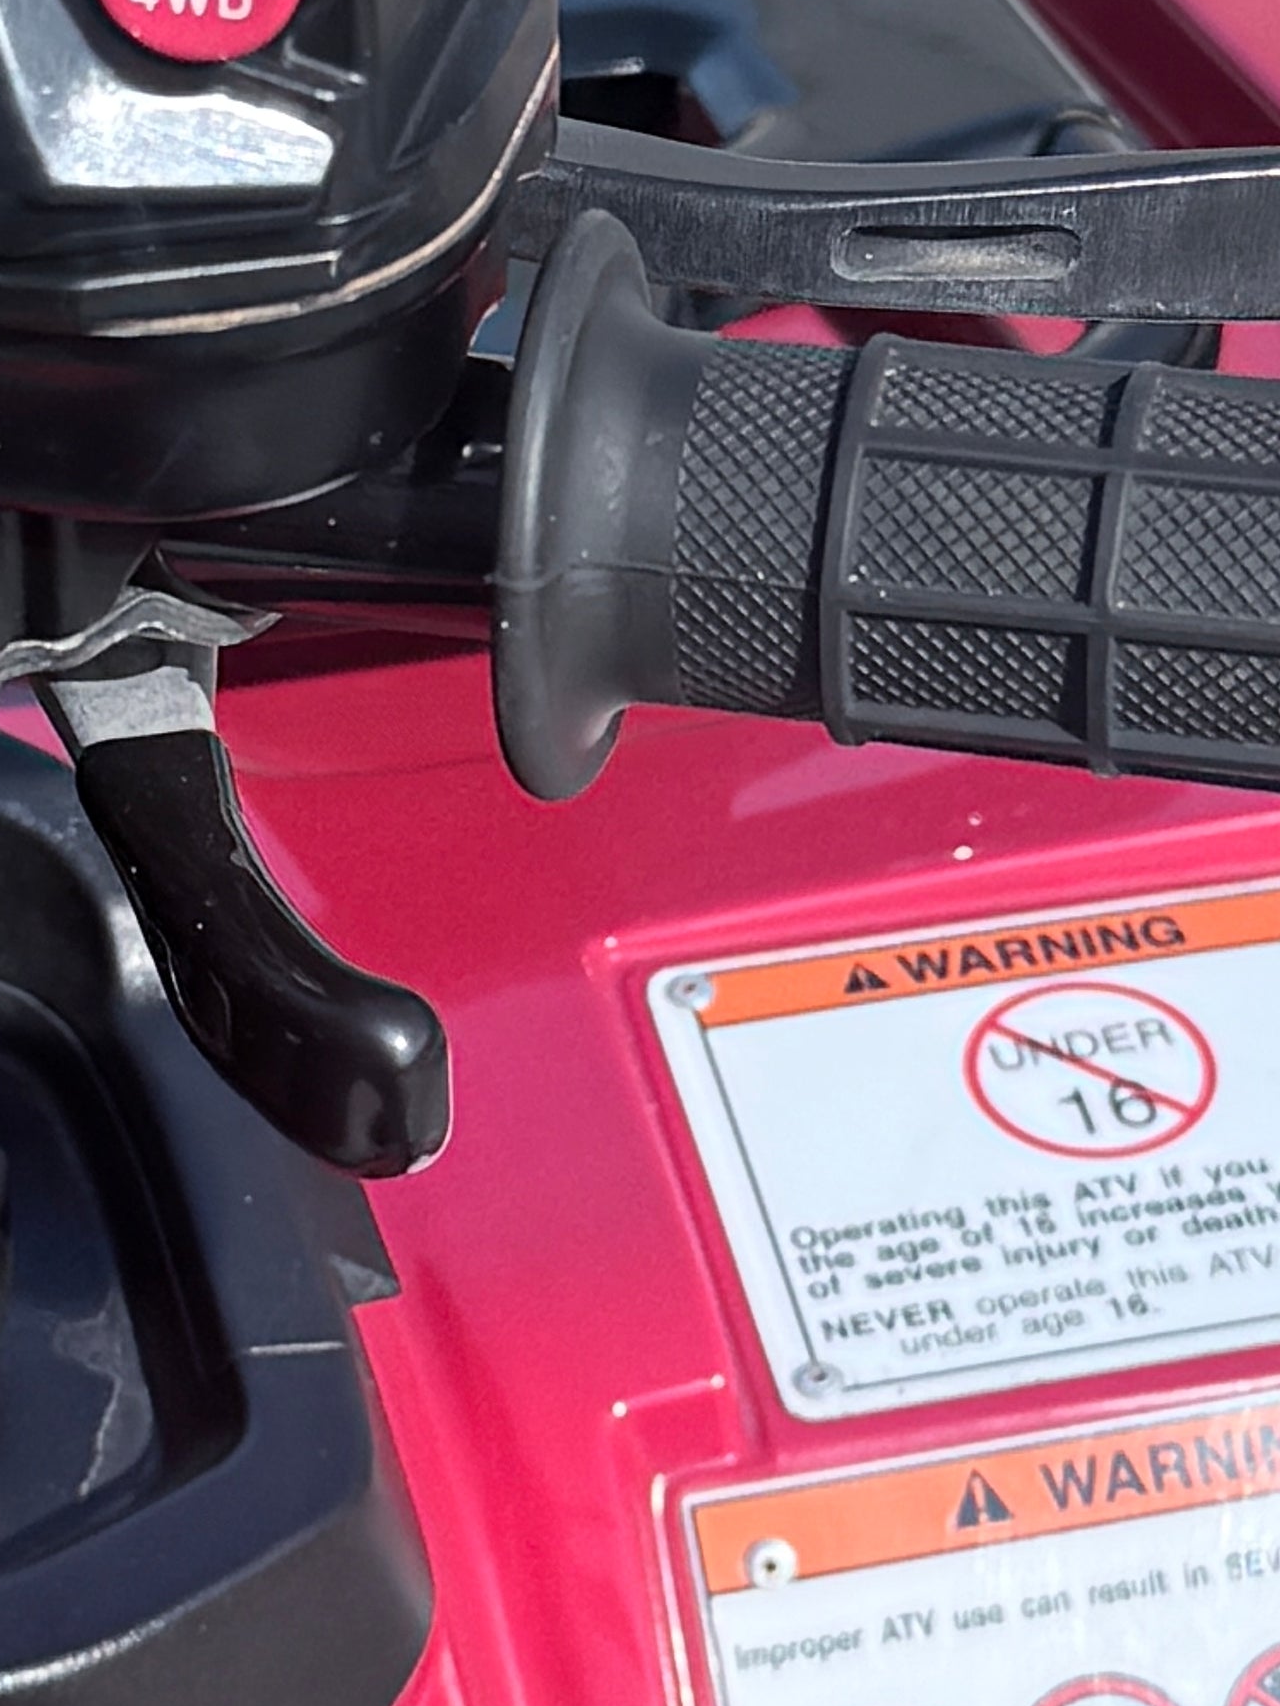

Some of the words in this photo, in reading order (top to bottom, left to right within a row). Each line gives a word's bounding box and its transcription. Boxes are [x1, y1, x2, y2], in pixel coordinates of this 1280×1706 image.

[898, 914, 1188, 981] WARNING
[985, 1016, 1176, 1073] UNDER
[1051, 1074, 1162, 1138] 16
[787, 1202, 968, 1253] Operating
[982, 1188, 1053, 1219] this
[1069, 1172, 1140, 1202] ATV
[1157, 1164, 1186, 1188] if
[1201, 1156, 1272, 1186] you
[796, 1244, 857, 1275] the
[874, 1236, 943, 1266] age
[956, 1221, 997, 1247] of
[1017, 1210, 1058, 1236] 16
[1074, 1182, 1248, 1228] increases
[803, 1273, 844, 1301] of
[862, 1254, 984, 1290] severe
[999, 1231, 1104, 1271] injury
[1121, 1224, 1163, 1248] or
[817, 1297, 956, 1342] NEVER
[971, 1273, 1111, 1320] operate
[1124, 1259, 1190, 1291] this
[1201, 1243, 1280, 1278] ATV
[733, 1628, 862, 1671] Improper
[880, 1607, 935, 1644] ATV
[952, 1602, 1005, 1632] use
[1019, 1589, 1072, 1620] can
[1087, 1569, 1170, 1606] result
[1182, 1562, 1210, 1589] in
